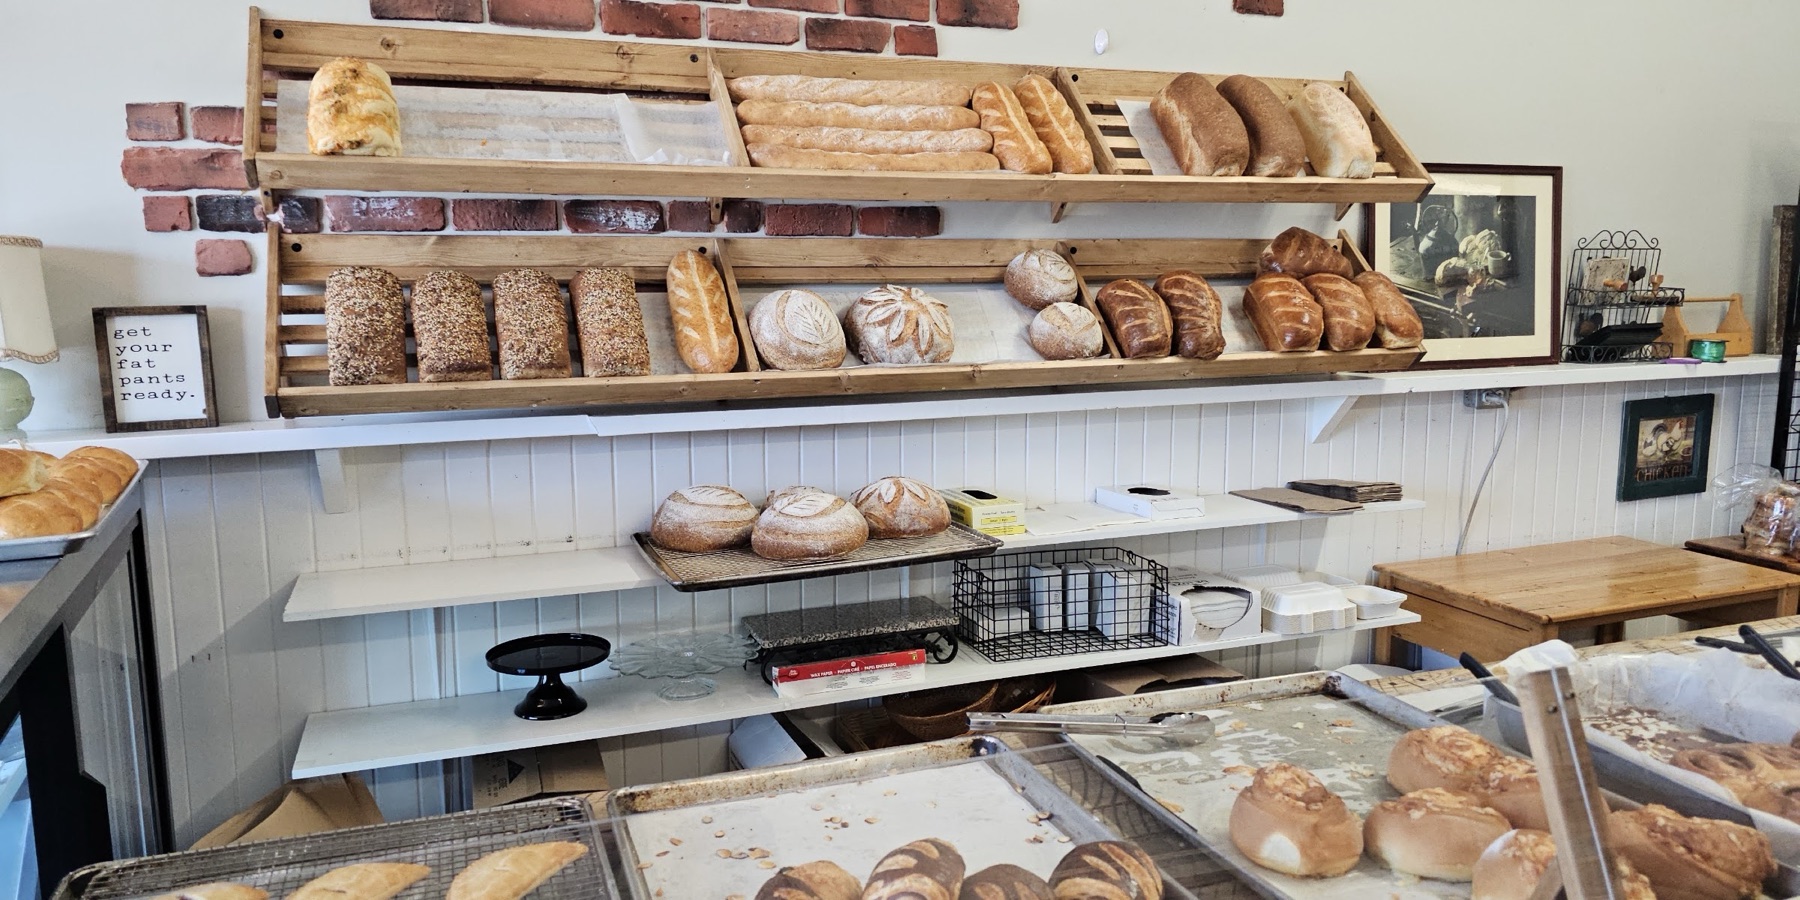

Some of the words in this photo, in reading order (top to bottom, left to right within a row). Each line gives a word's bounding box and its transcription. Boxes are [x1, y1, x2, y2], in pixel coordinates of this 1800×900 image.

[113, 326, 152, 340] get
[115, 344, 173, 357] your
[117, 358, 156, 370] fat
[118, 373, 186, 388] pants
[120, 389, 195, 401] ready.
